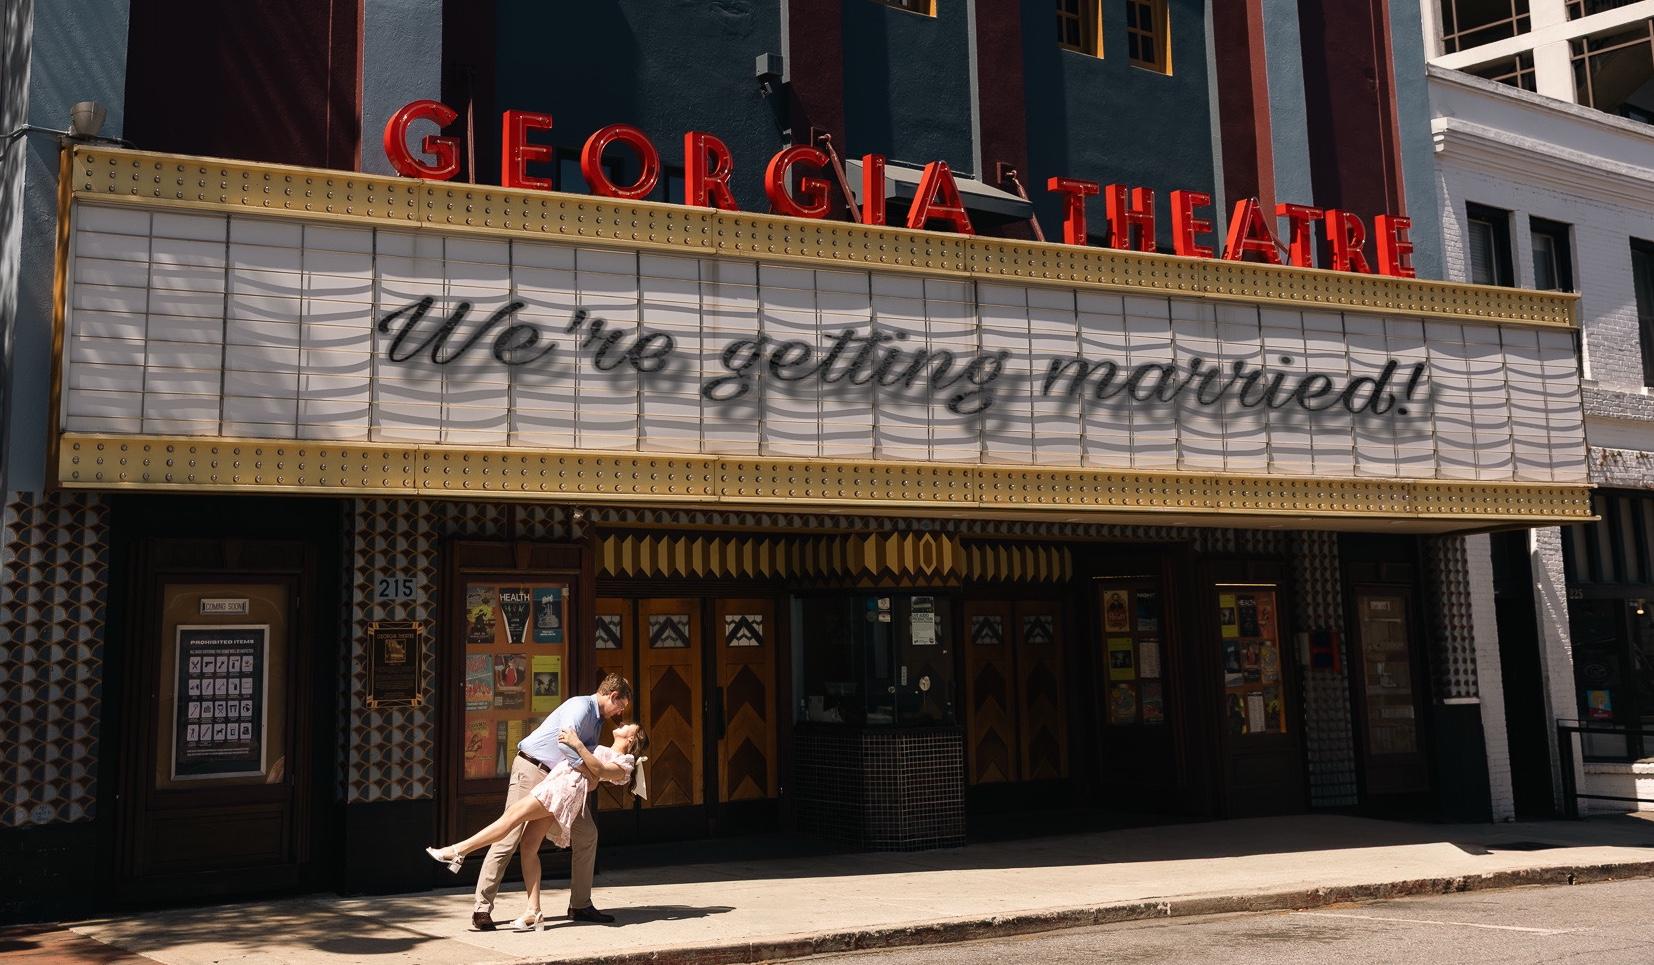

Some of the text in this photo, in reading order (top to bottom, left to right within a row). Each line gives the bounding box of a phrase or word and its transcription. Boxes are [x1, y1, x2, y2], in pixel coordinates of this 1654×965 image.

[384, 99, 1416, 278] GEORGIA THEATRE
[378, 296, 1425, 416] We're getting married!
[379, 579, 413, 597] 215
[206, 602, 242, 610] COMING SOON
[499, 593, 530, 602] HEALTH
